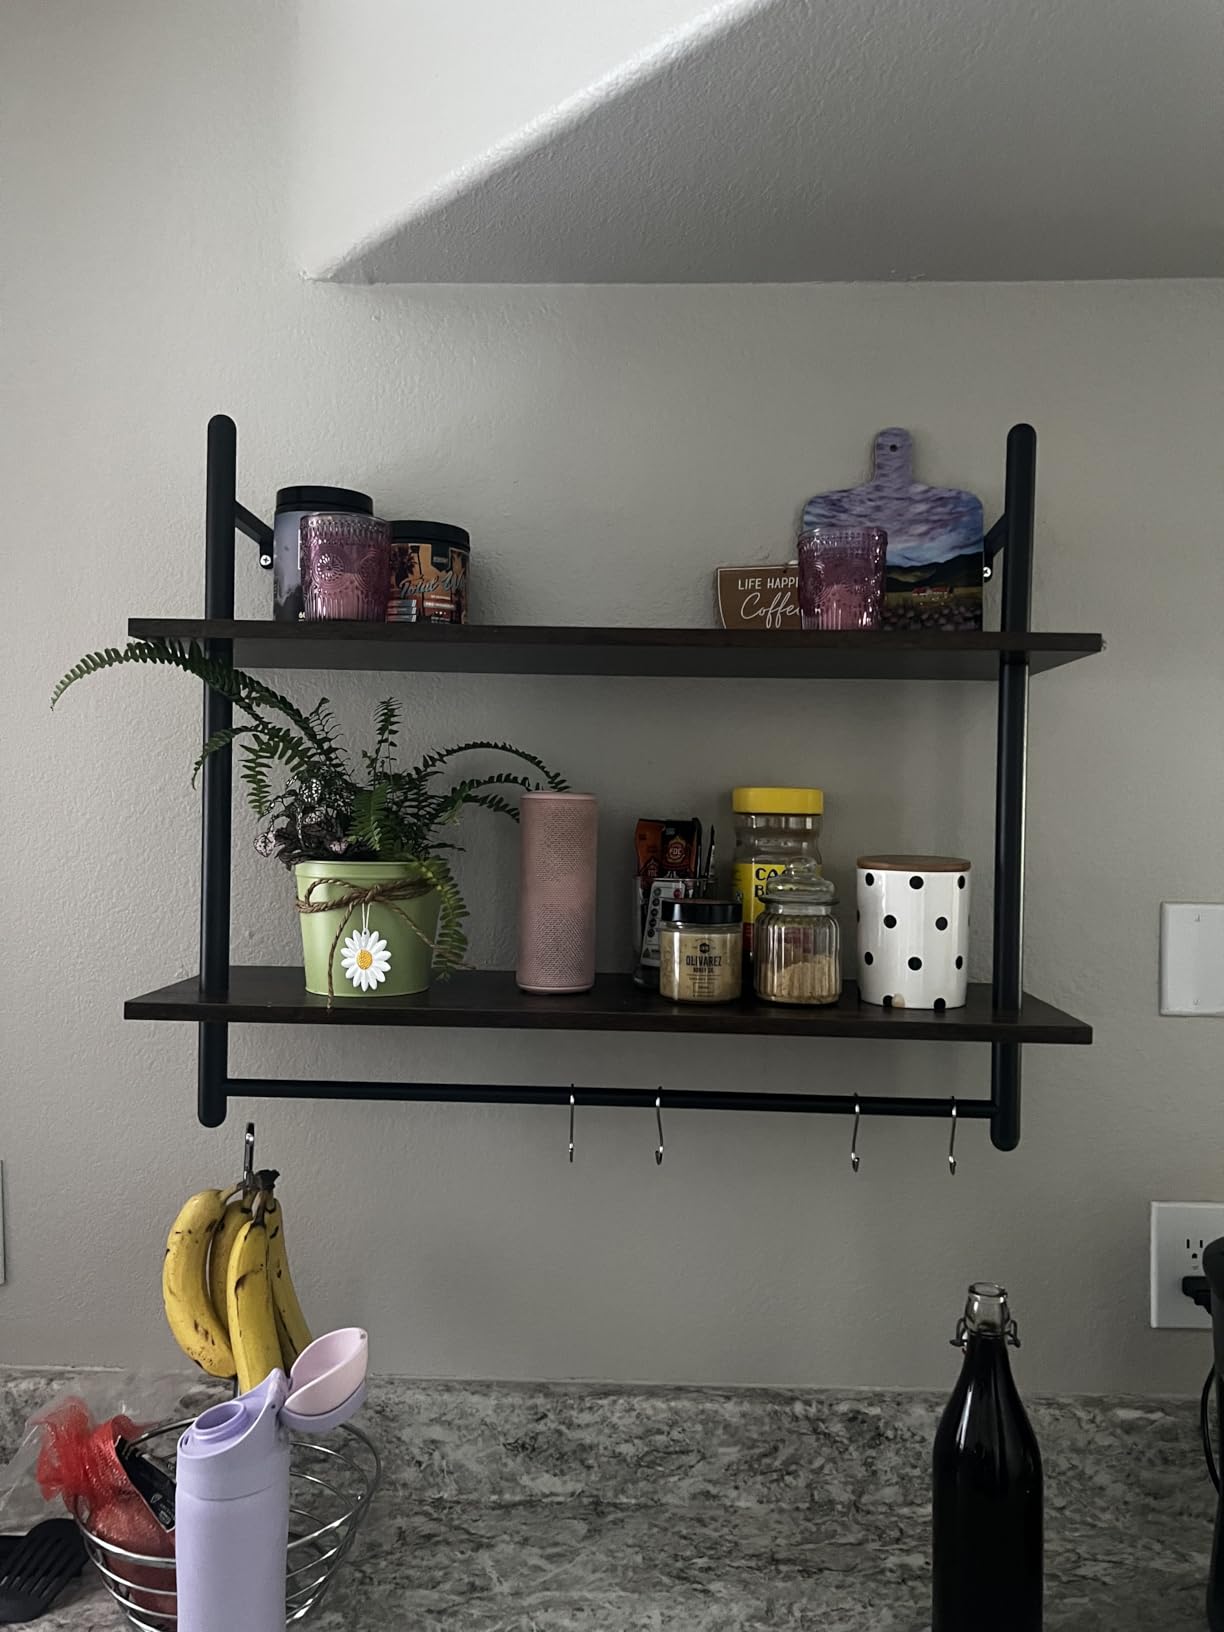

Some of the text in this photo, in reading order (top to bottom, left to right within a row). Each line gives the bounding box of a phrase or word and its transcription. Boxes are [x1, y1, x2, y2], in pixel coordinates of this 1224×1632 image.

[738, 578, 762, 590] LIFE
[755, 867, 786, 881] CA
[686, 955, 722, 967] OLIVAREZ
